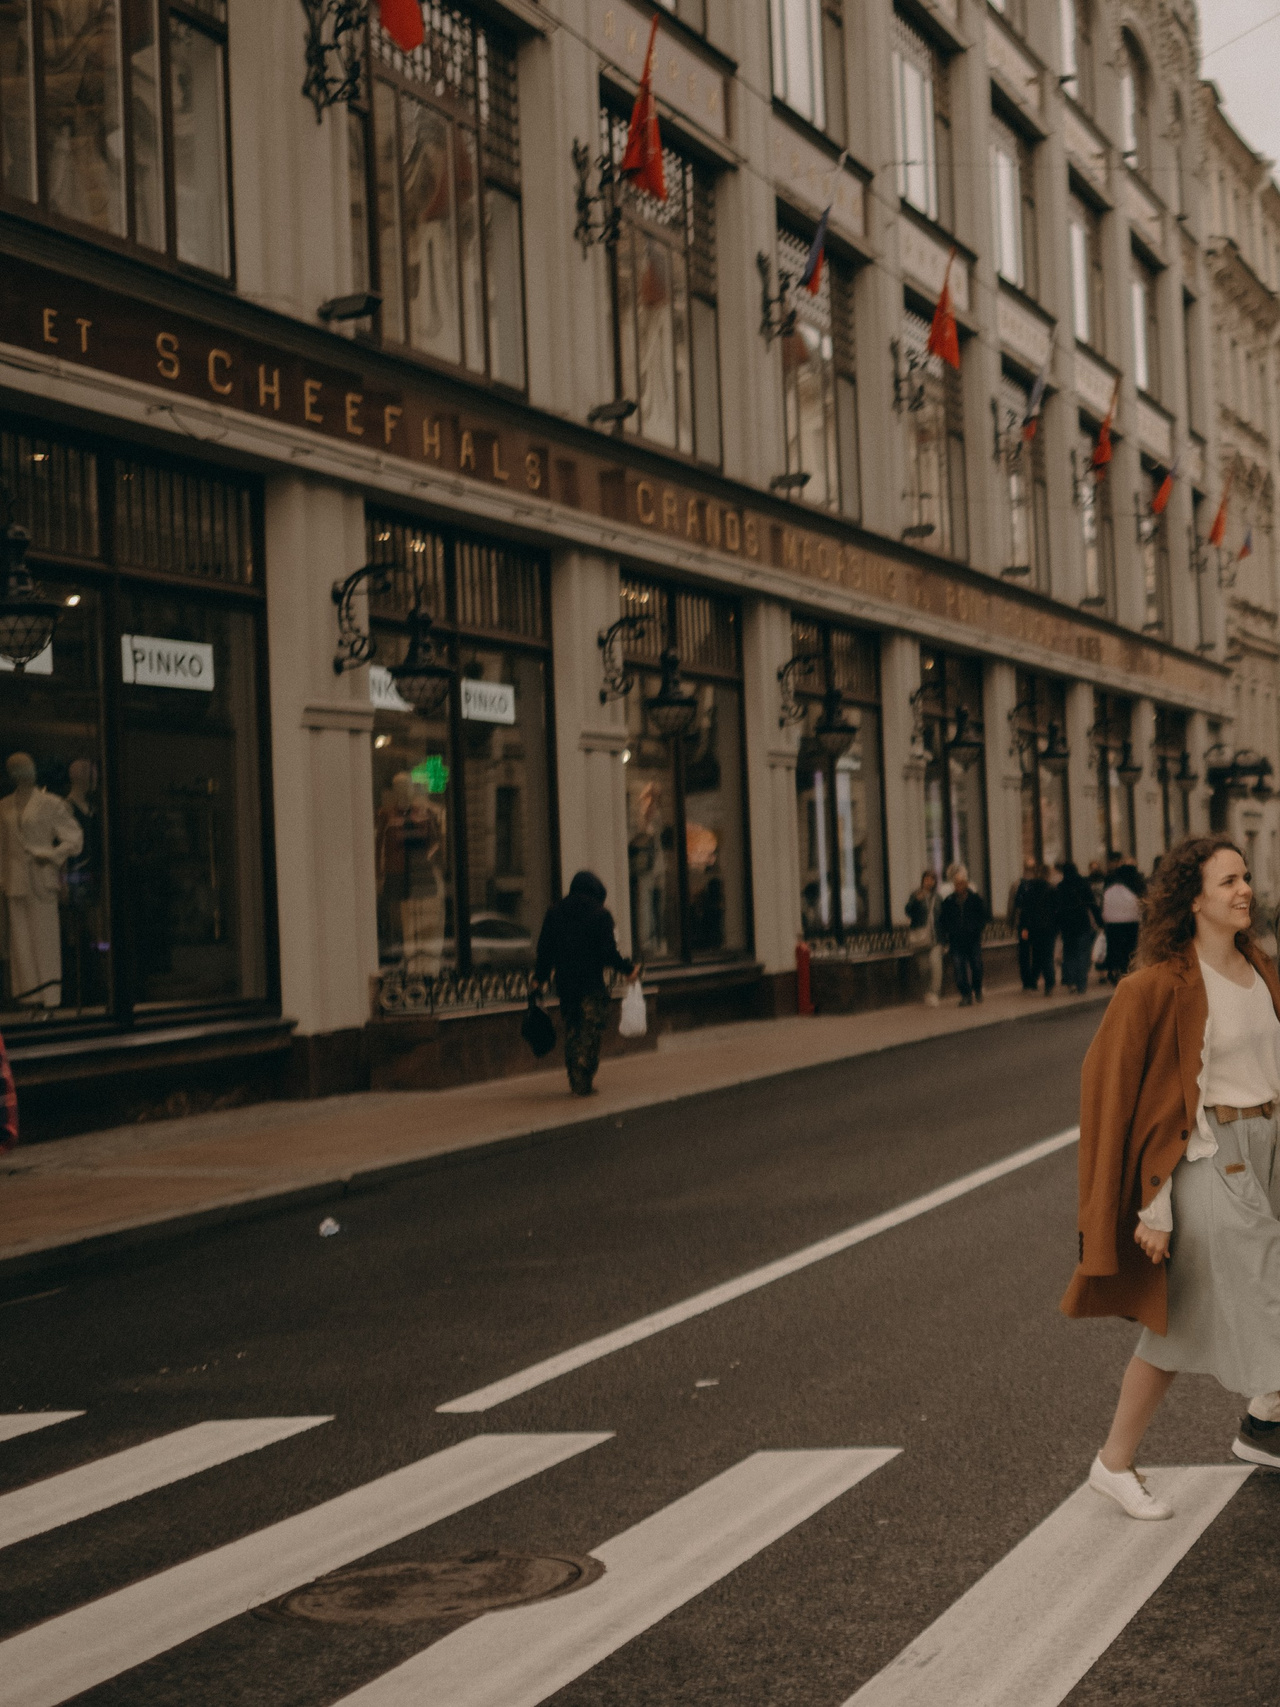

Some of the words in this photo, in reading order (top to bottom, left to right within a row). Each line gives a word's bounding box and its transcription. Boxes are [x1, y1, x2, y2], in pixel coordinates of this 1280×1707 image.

[43, 308, 92, 353] ET
[156, 331, 542, 490] SCHEEFHALS
[131, 646, 204, 679] PINKO
[464, 685, 509, 715] PINKO
